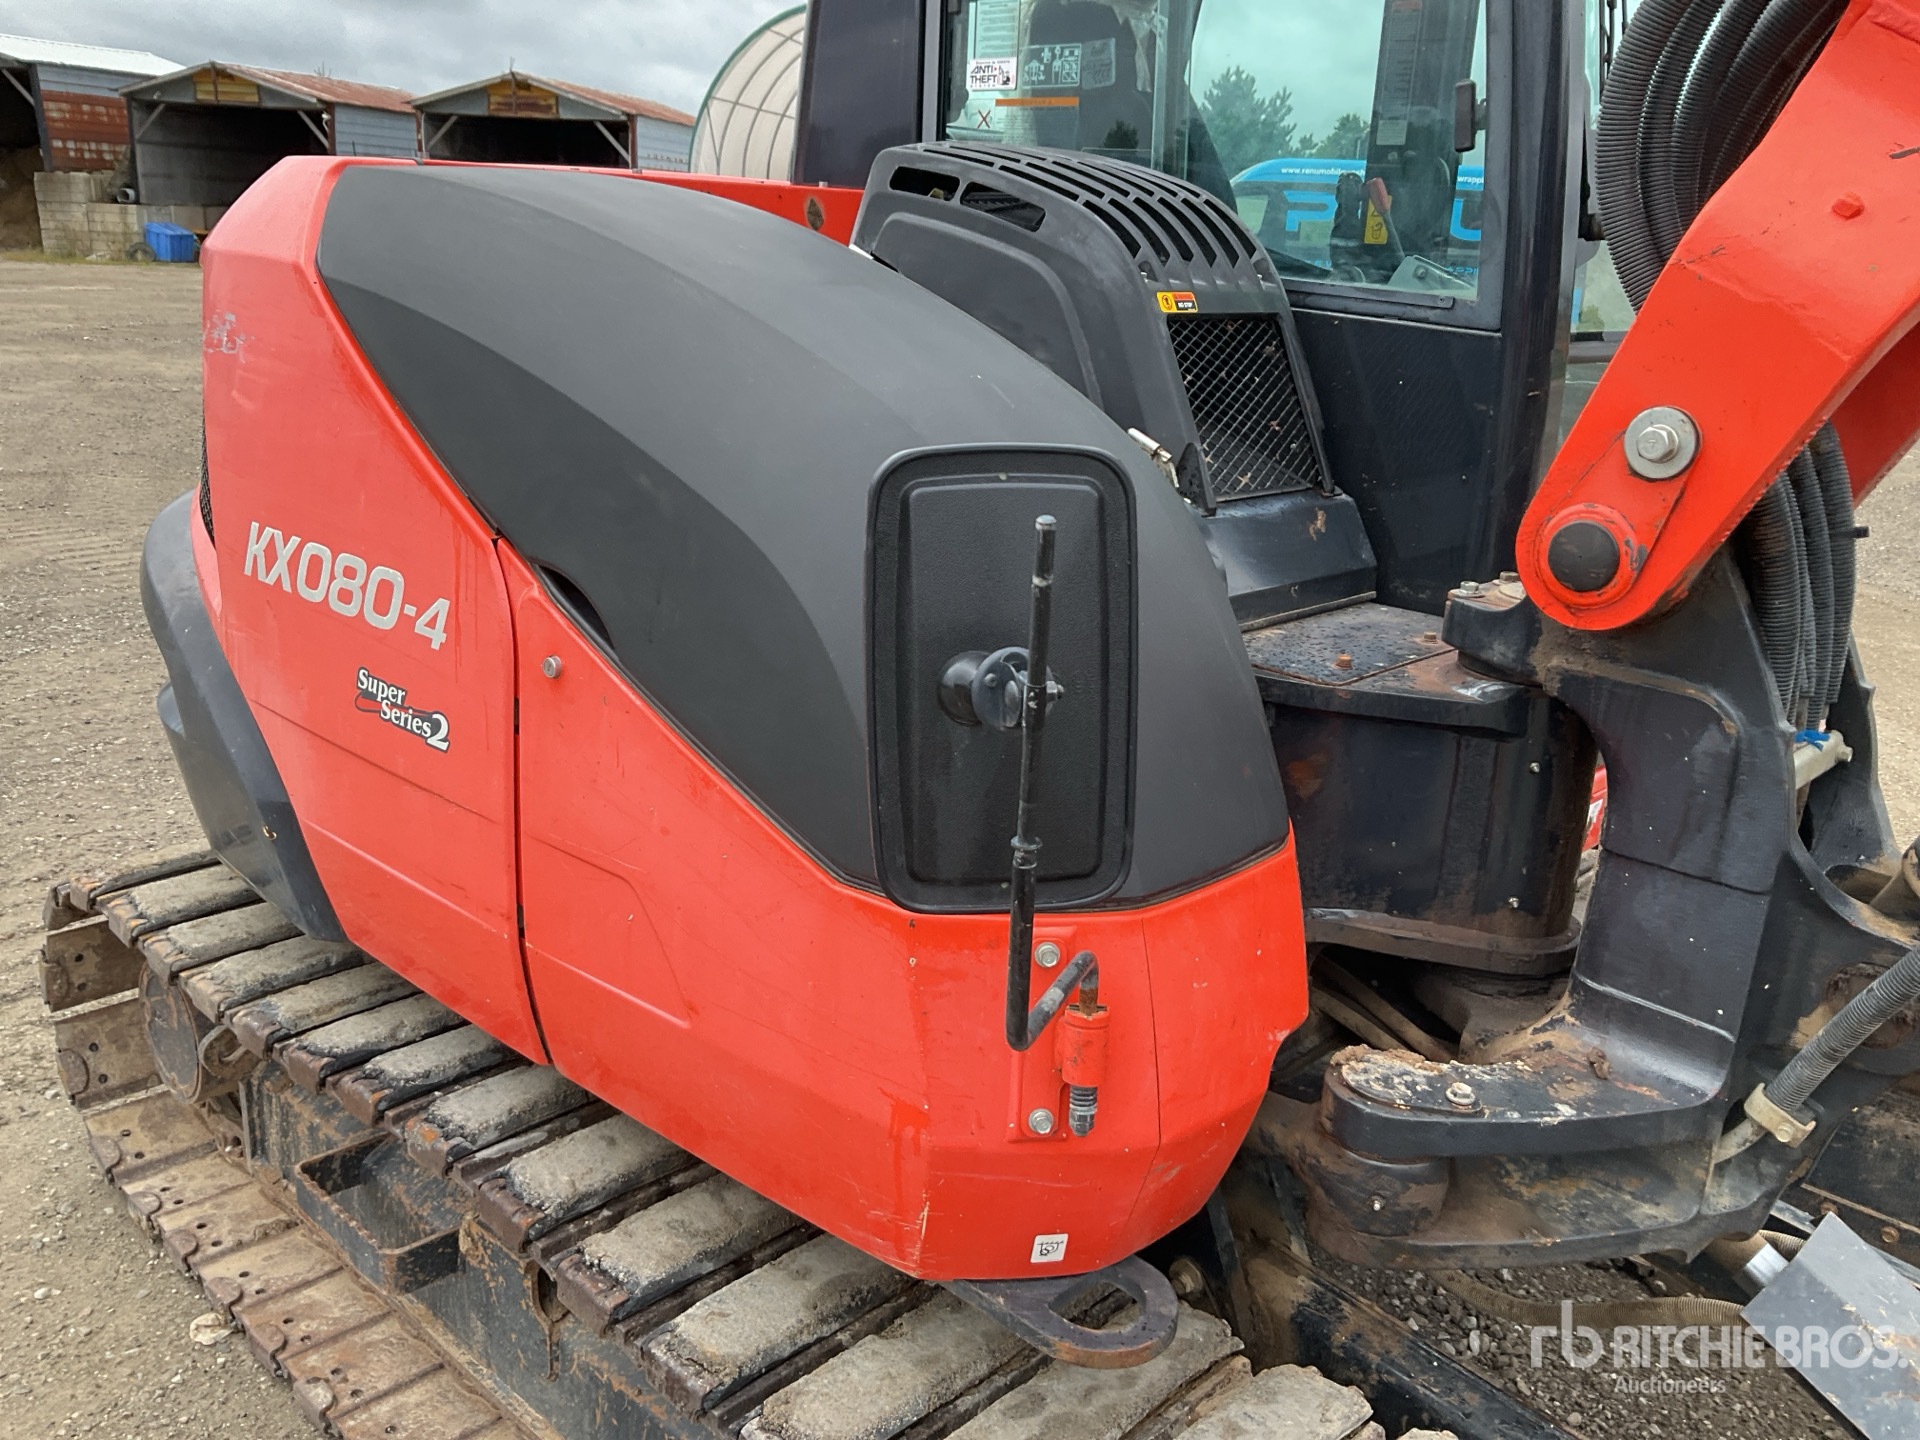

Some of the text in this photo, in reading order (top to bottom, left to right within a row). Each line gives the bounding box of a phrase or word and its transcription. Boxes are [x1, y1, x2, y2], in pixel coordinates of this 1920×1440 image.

[970, 74, 997, 84] THEFT
[244, 521, 450, 651] KX080-4
[357, 669, 406, 706] Super
